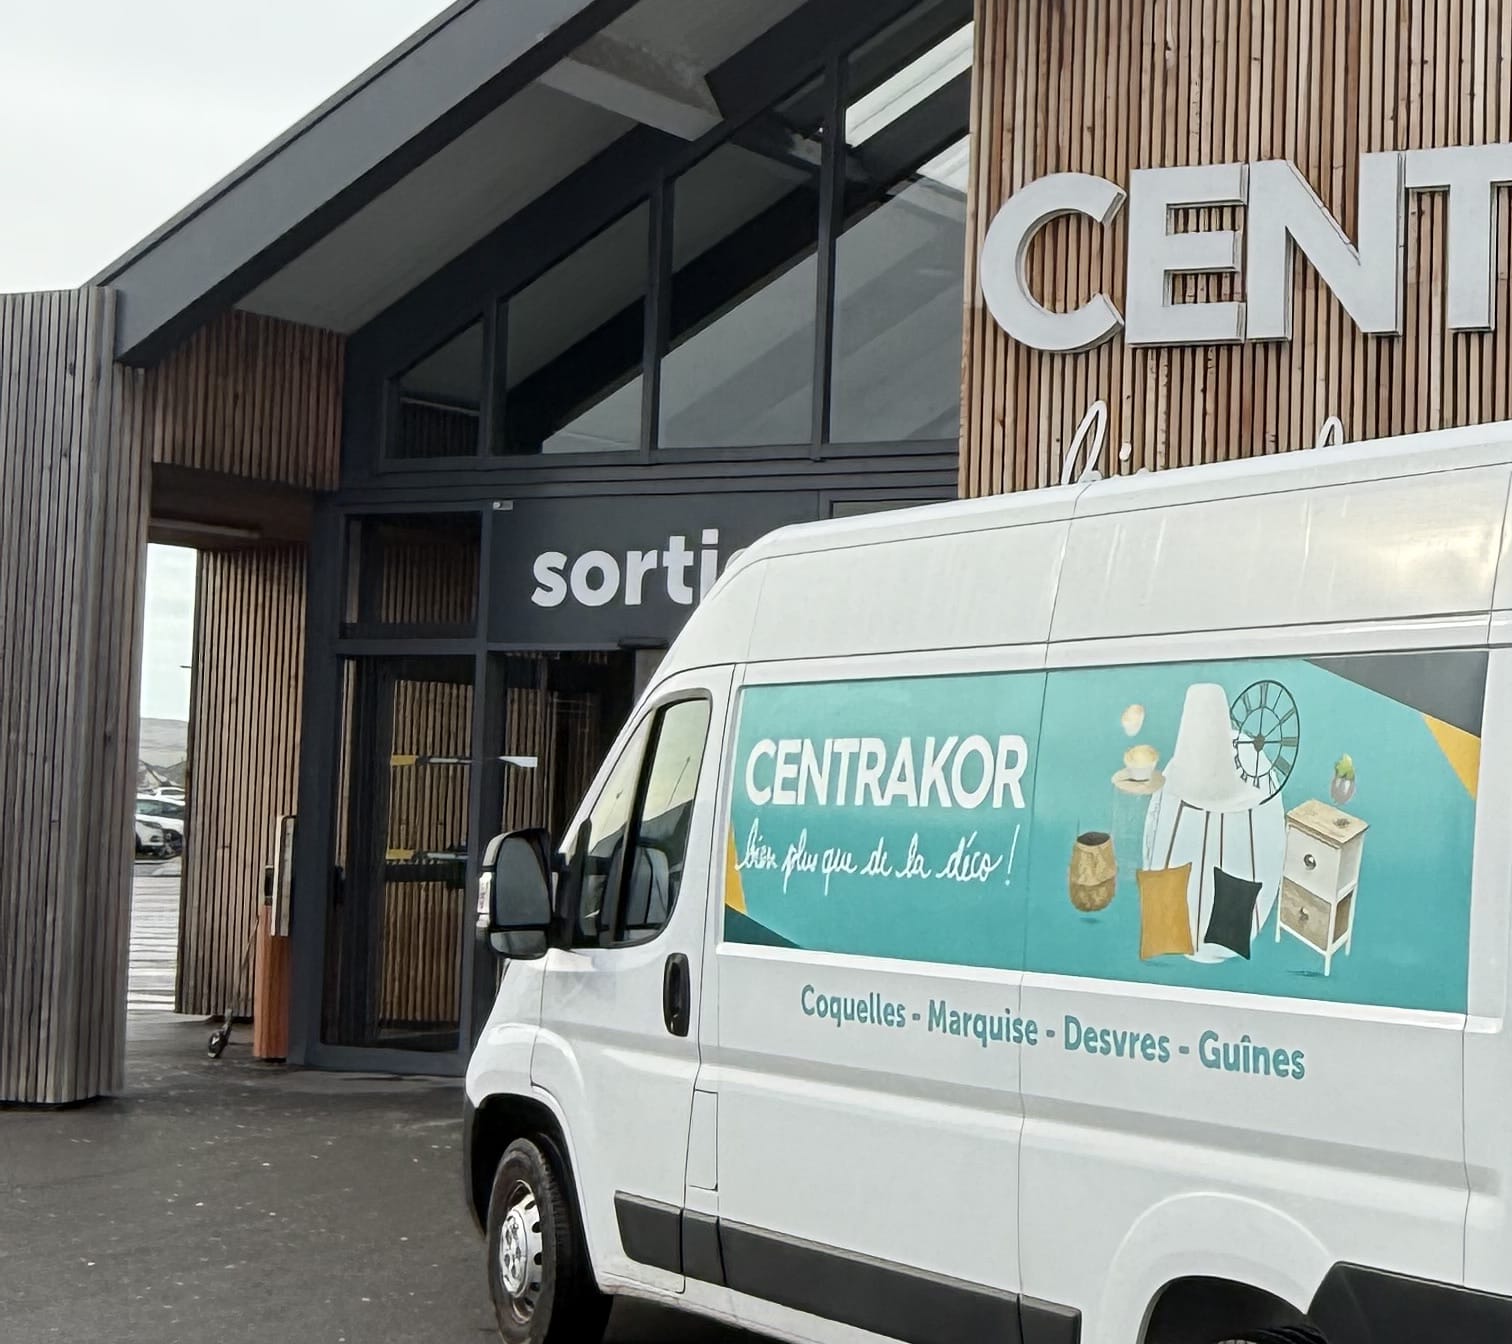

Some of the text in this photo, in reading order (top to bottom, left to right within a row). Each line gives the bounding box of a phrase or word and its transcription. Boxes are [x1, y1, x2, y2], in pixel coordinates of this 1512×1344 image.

[530, 529, 747, 607] sorti
[744, 733, 1027, 809] CENTRAKOR
[735, 818, 778, 871] bien
[822, 847, 857, 896] que
[860, 836, 893, 877] de
[896, 832, 932, 879] la
[800, 984, 906, 1028] Coquelles
[927, 999, 1038, 1048] Marquise
[1064, 1015, 1171, 1063] Desvres
[1199, 1030, 1306, 1081] Guînes
